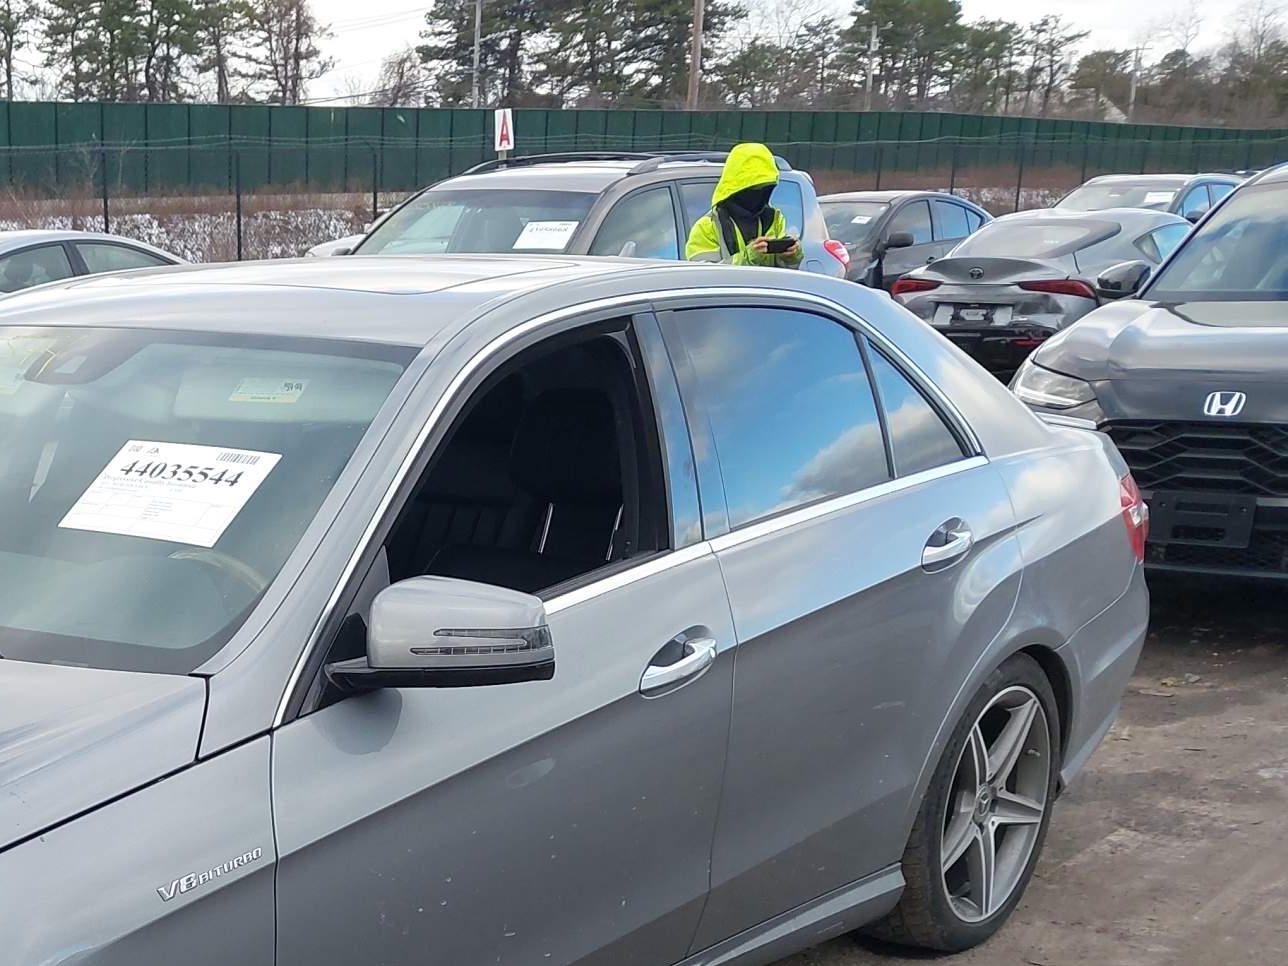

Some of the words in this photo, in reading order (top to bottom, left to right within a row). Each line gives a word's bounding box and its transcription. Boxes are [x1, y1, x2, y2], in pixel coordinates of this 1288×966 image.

[499, 110, 511, 147] A
[120, 459, 245, 488] 44035544
[156, 872, 198, 902] V8
[198, 847, 263, 886] BITURBO
